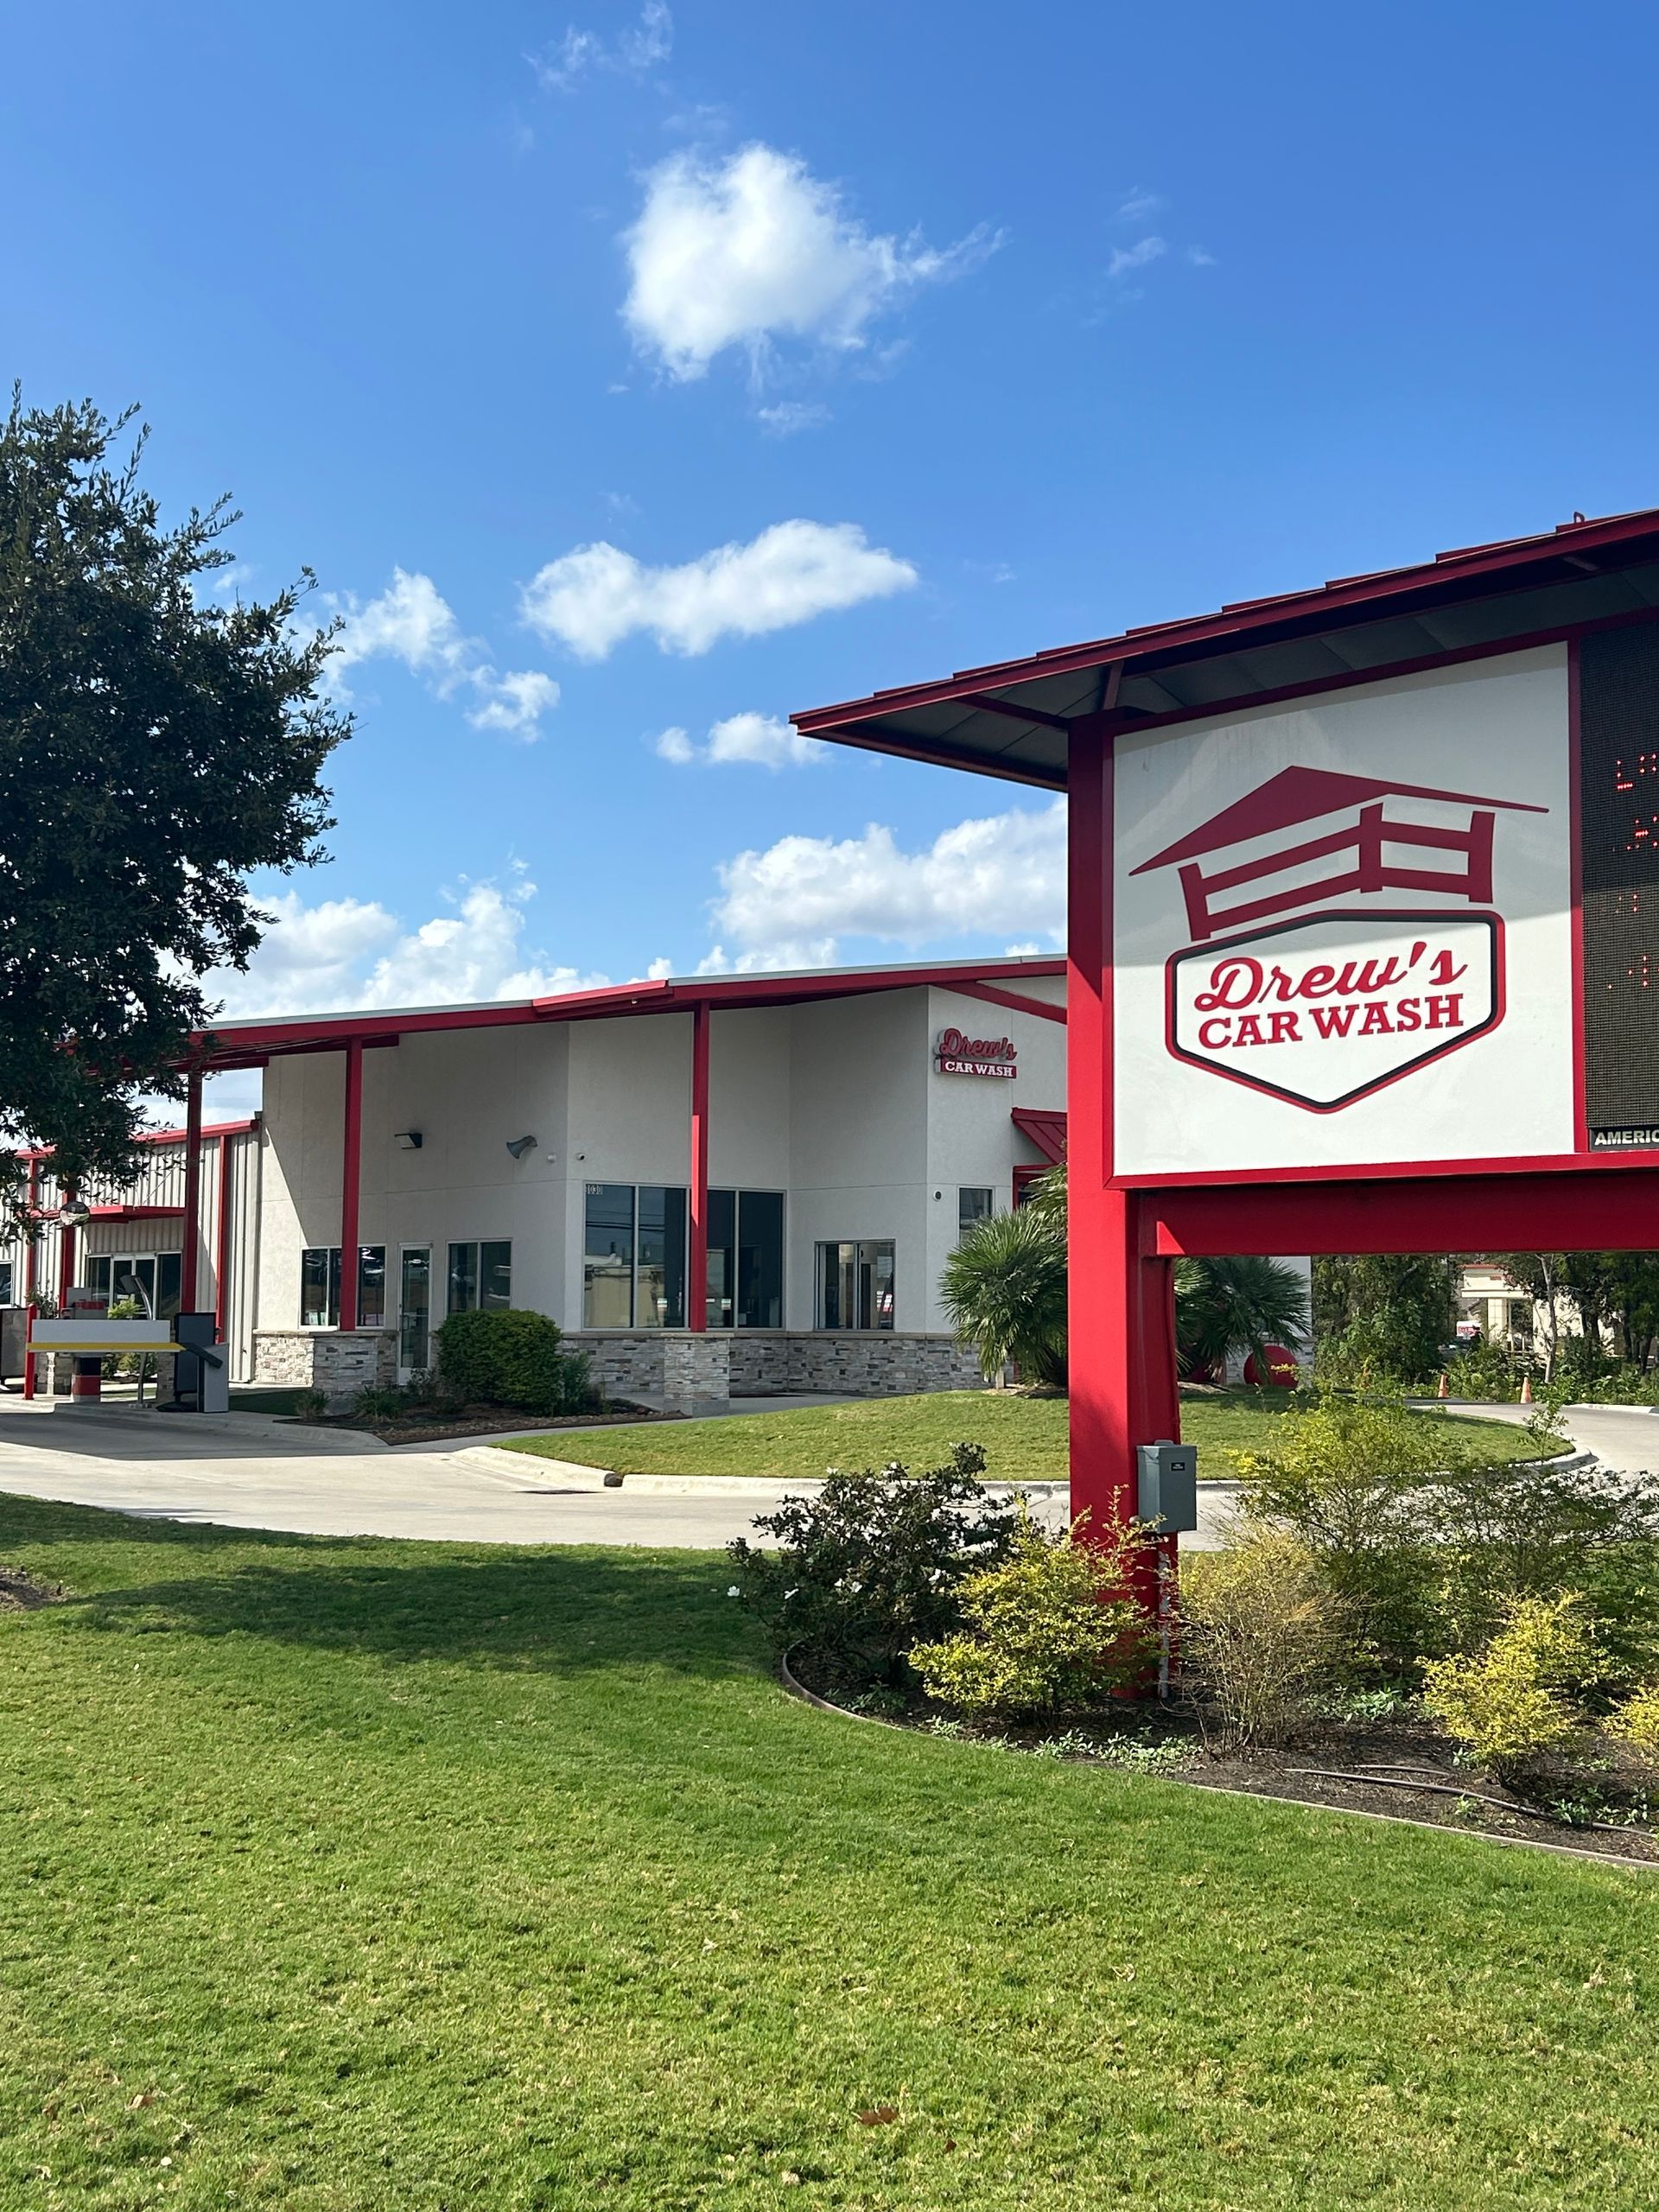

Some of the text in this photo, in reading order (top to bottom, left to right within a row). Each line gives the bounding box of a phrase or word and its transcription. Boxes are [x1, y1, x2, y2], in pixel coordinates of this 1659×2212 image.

[1194, 941, 1468, 1012] Drew's
[1198, 993, 1464, 1049] CAR WASH
[939, 1027, 1017, 1061] Drew's
[944, 1061, 1014, 1077] CAR WASH
